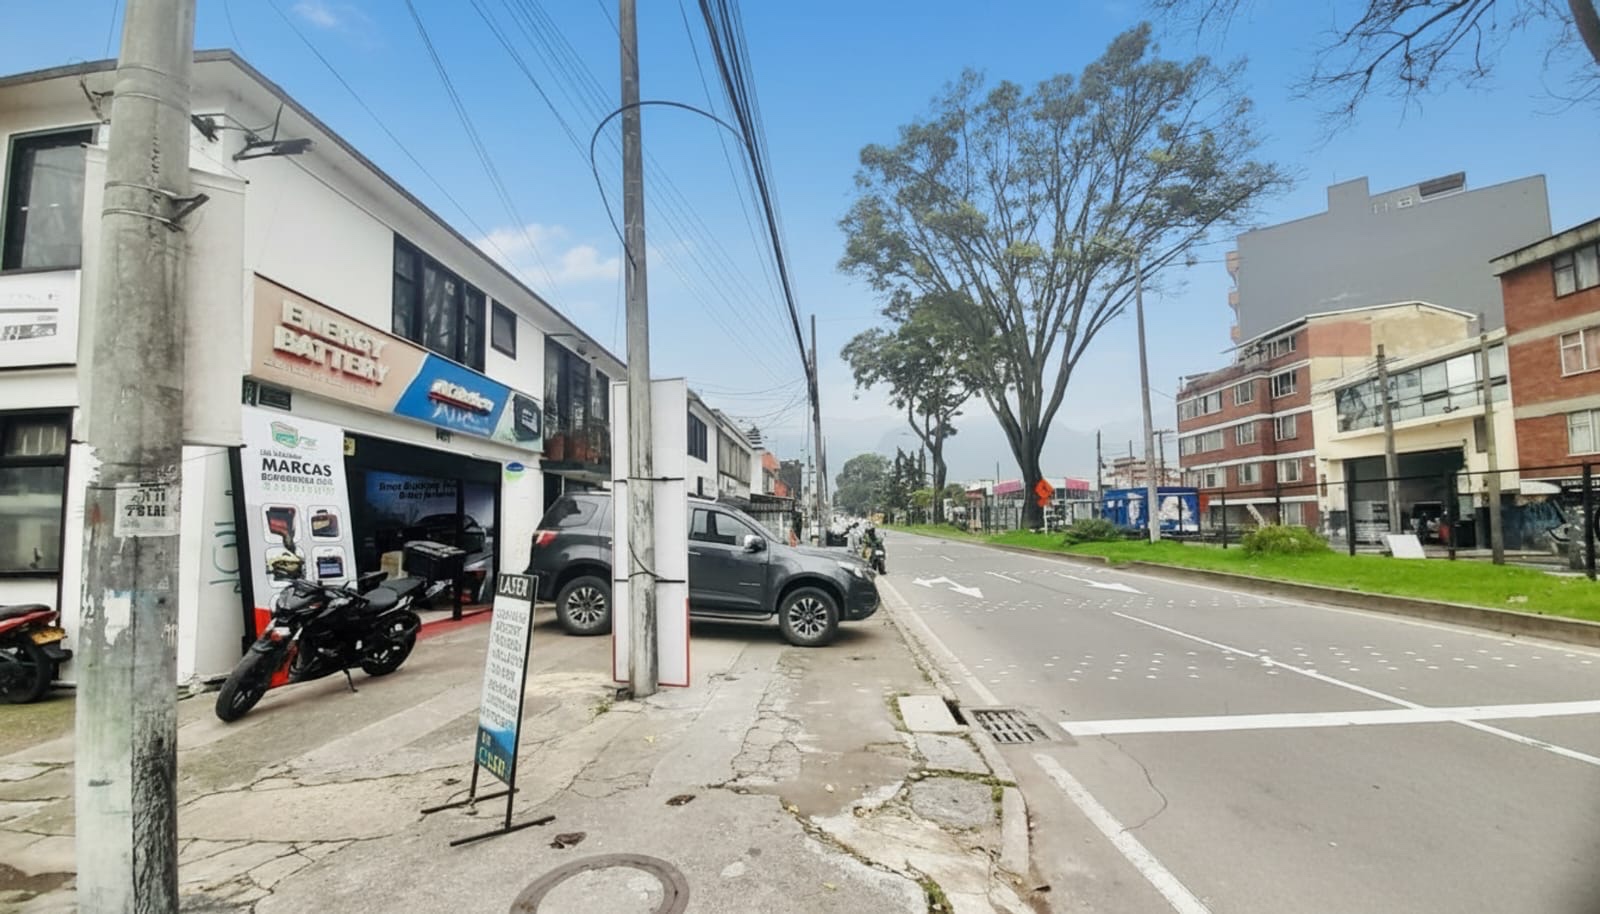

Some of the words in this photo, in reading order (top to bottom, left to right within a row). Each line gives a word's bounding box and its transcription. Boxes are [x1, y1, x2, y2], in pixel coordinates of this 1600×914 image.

[272, 324, 391, 385] BATTERY
[281, 298, 388, 358] ENERGY
[261, 457, 333, 478] MARCAS
